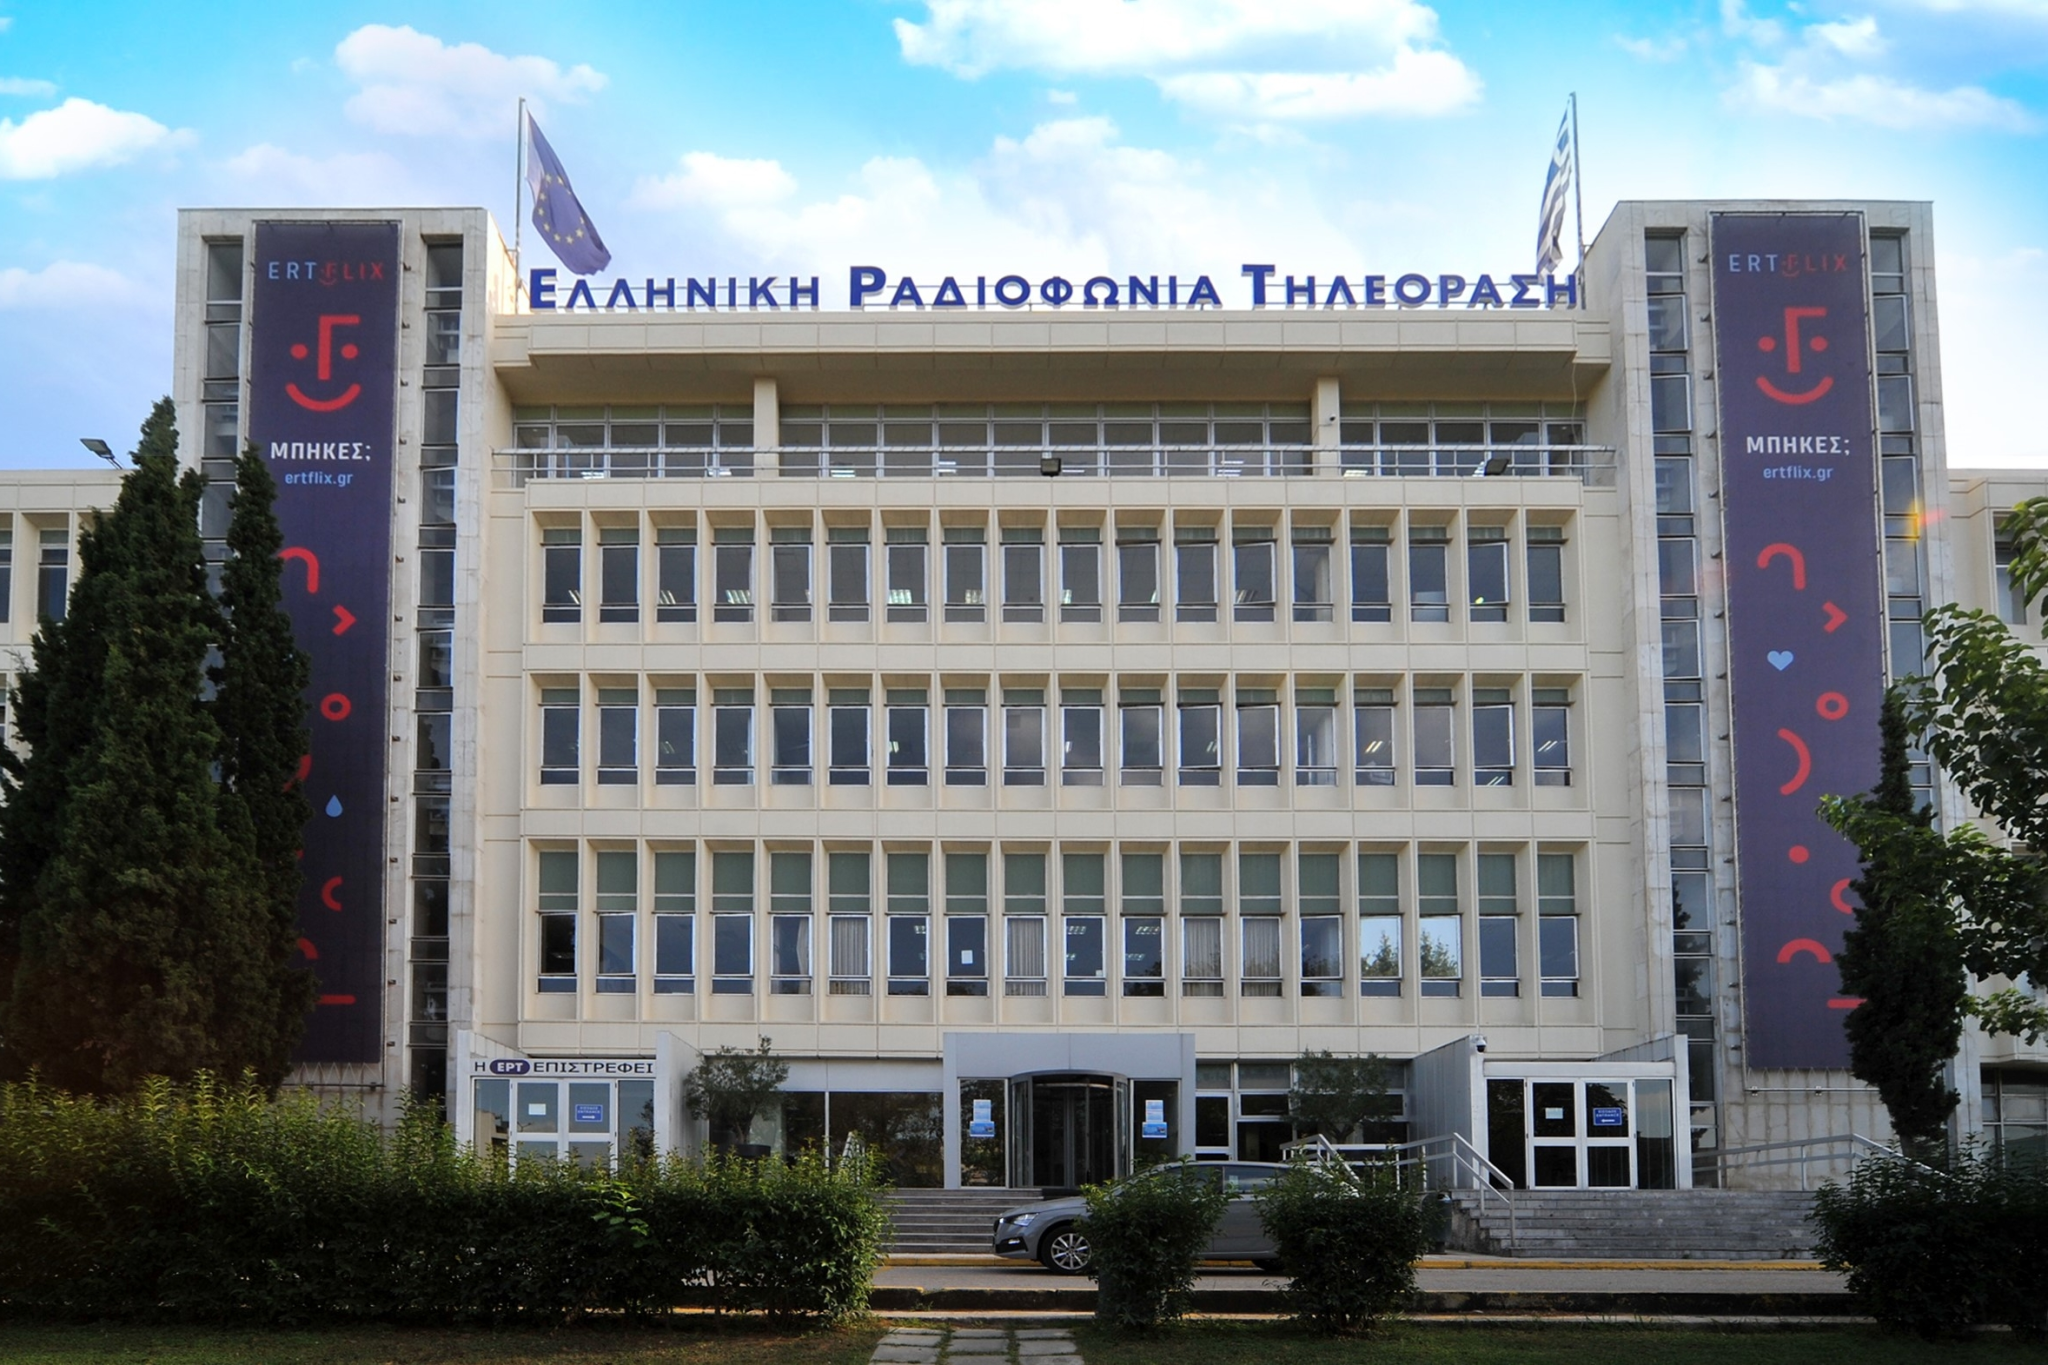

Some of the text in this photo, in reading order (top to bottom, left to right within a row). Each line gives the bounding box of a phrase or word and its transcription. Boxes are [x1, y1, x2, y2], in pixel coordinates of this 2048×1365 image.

[530, 264, 1578, 310] ΕΛΛΗΝΙΚΗ ΡΑΔΙΟΦΩΝΙΑ ΤΗΛΕΟΡΑΣΗ
[270, 442, 371, 461] ΜΠΗΚΕΣ;
[1746, 436, 1850, 456] ΜΠΗΚΕΣ;
[284, 471, 354, 487] ertflix.gr
[1763, 466, 1834, 482] ertflix.gr
[474, 1062, 654, 1074] Η ΕΡΤ ΕΠΙΣΤΡΕΦΕΙ
